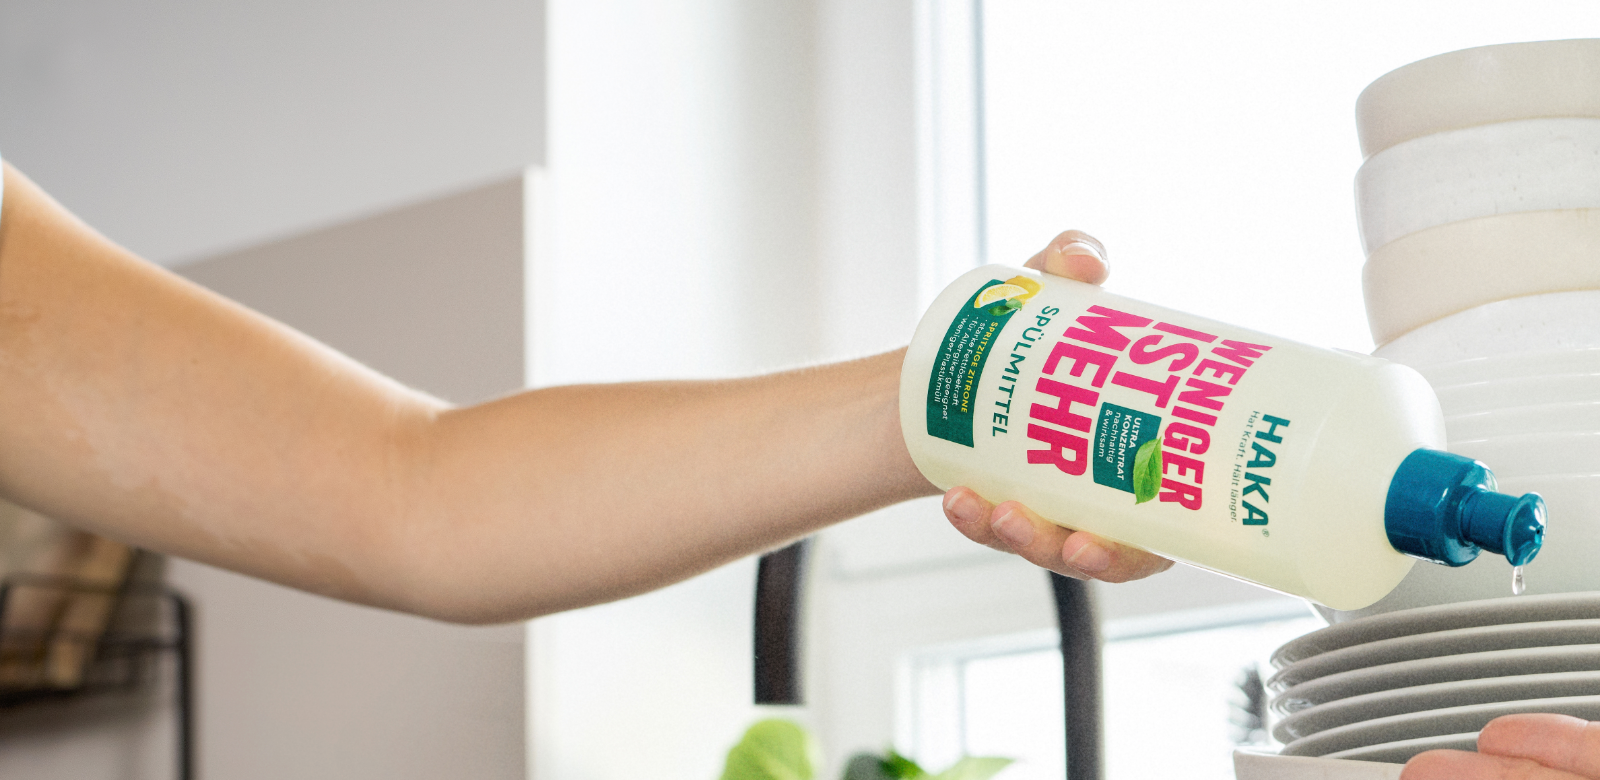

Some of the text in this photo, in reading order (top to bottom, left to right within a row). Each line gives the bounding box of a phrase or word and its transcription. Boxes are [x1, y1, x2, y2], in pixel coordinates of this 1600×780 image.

[934, 317, 967, 403] weniger Plastikmüll
[941, 320, 978, 420] für Allergiker geeignet
[952, 322, 986, 406] starke Fettlösekraft
[961, 321, 998, 413] SPRITZIGE ZITRONE
[992, 305, 1060, 437] SPÜLMITTEL
[1027, 305, 1154, 476] MEHR
[1111, 322, 1219, 409] IST
[1098, 409, 1113, 458] & wirksam
[1106, 412, 1121, 463] nachhaltig
[1117, 414, 1132, 480] KONZENTRAT
[1128, 417, 1142, 448] ULTRA
[1159, 339, 1273, 511] WENIGER
[1228, 410, 1260, 523] Hat Kraft. Hält länger.
[1242, 414, 1291, 525] HAKA
